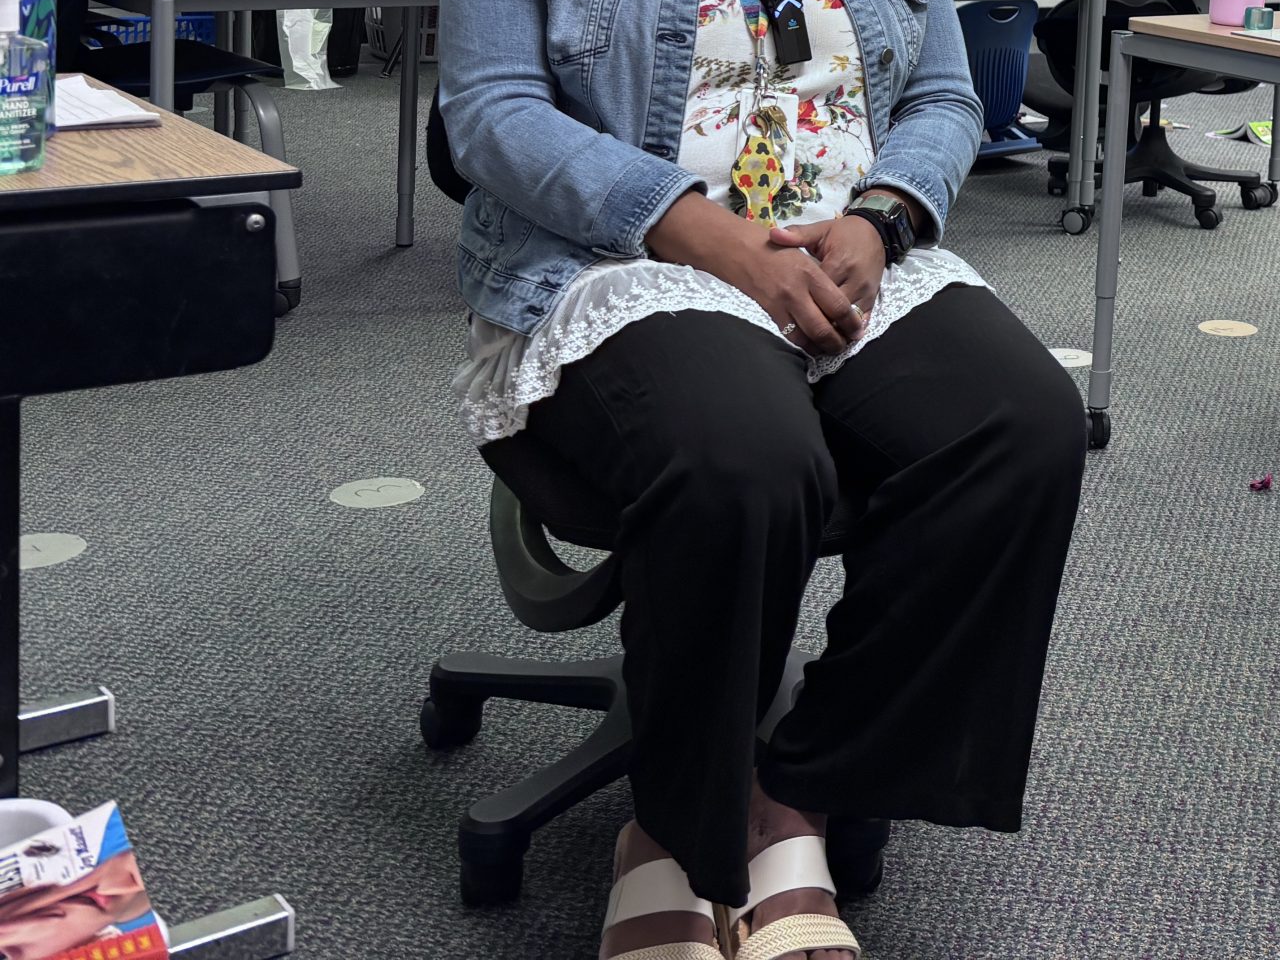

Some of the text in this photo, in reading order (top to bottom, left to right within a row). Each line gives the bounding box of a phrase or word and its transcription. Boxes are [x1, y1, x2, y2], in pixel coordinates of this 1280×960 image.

[0, 77, 36, 93] Purell
[2, 101, 30, 110] HAND
[0, 108, 37, 118] ANITIZER
